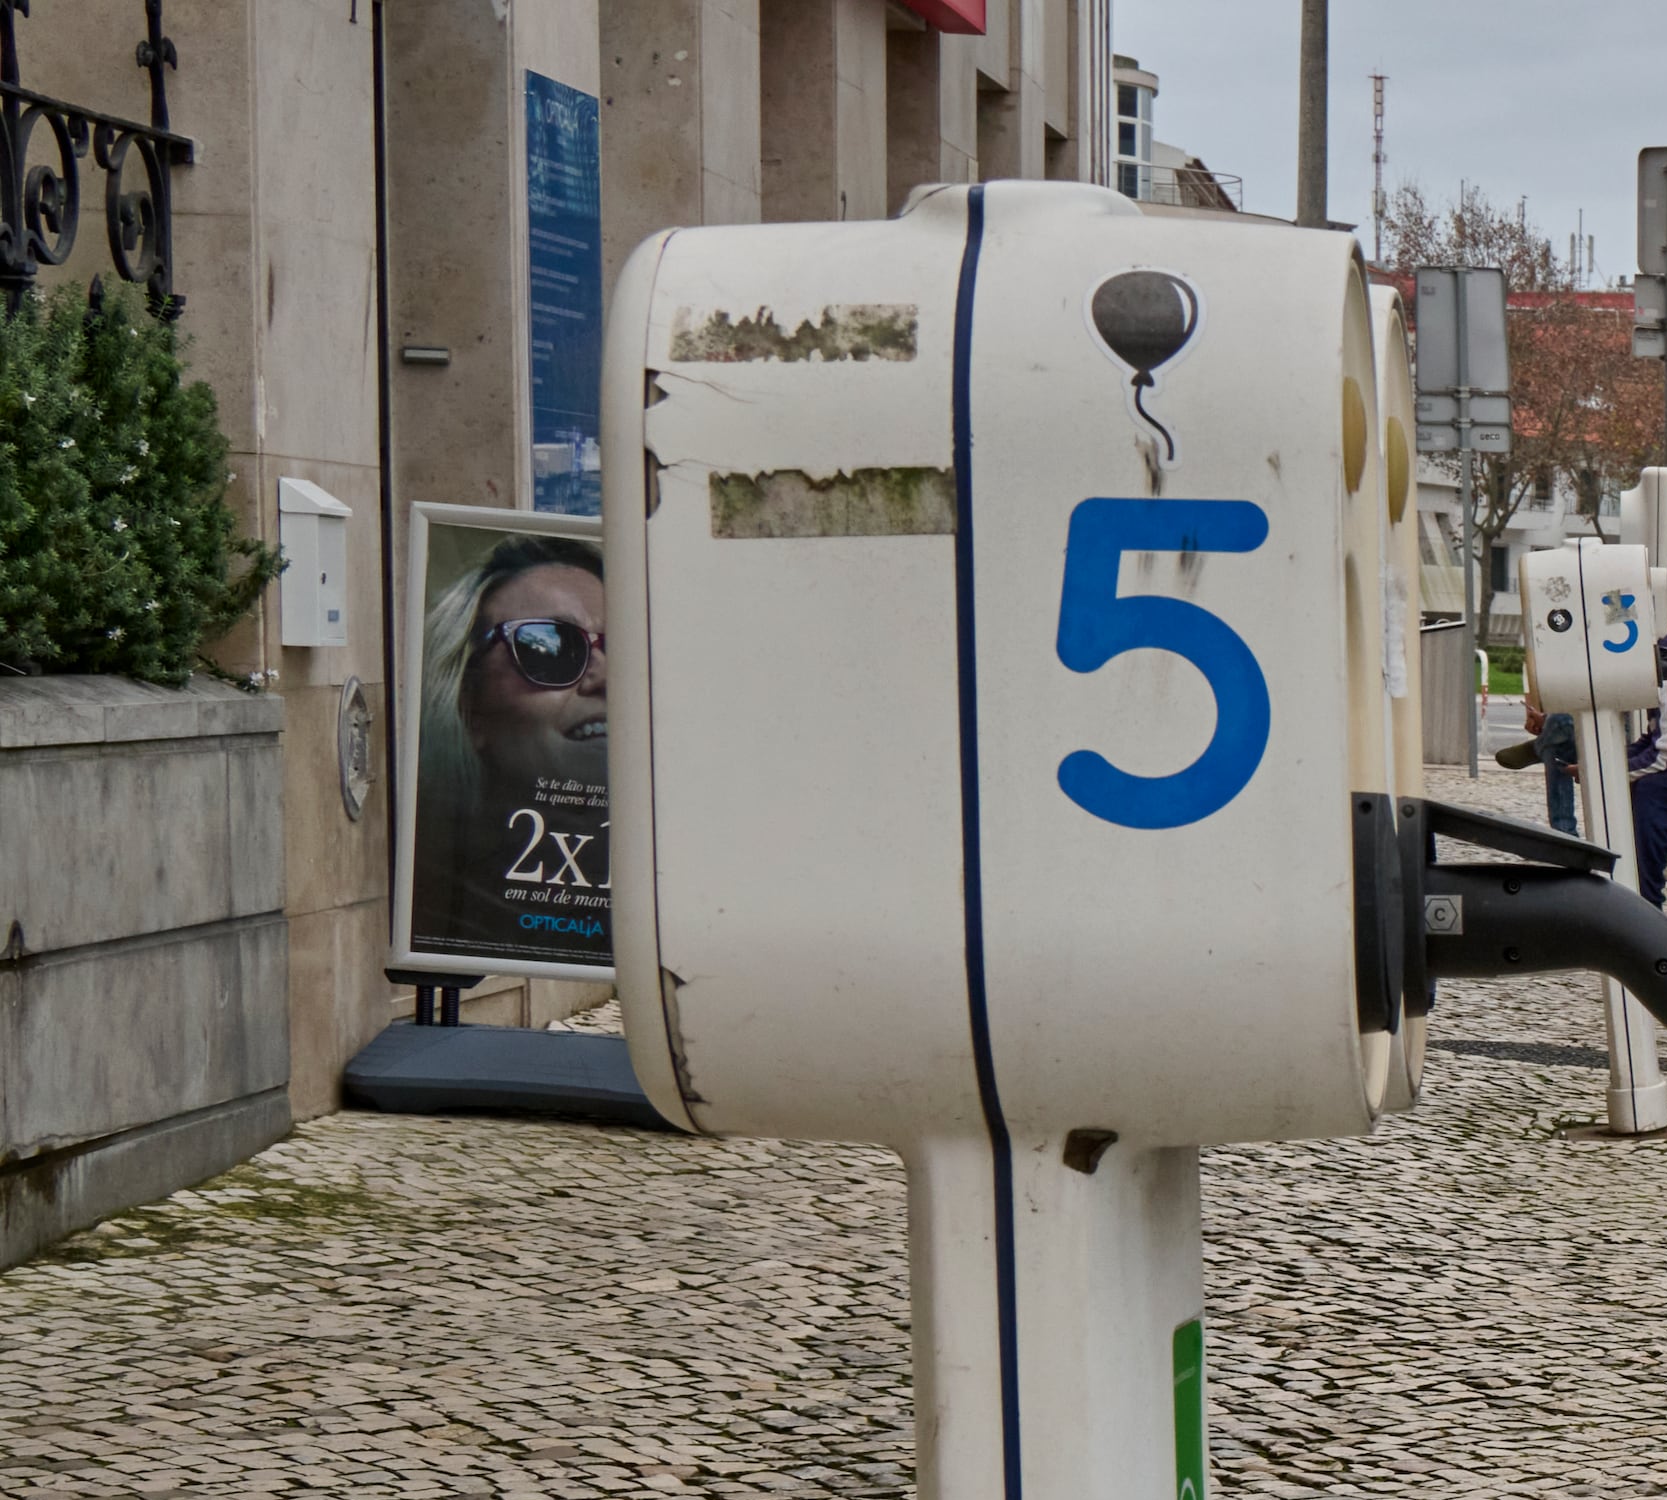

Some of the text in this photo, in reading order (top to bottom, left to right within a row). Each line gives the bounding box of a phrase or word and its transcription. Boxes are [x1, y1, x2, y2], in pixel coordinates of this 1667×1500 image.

[1601, 594, 1639, 653] 3
[1056, 497, 1271, 830] 5
[535, 776, 549, 789] Se
[550, 778, 561, 790] te
[562, 779, 583, 793] dão
[535, 791, 547, 802] tu
[549, 793, 585, 807] queres
[504, 888, 526, 901] em
[530, 888, 551, 903] sol
[553, 889, 572, 905] de
[1434, 907, 1446, 922] C
